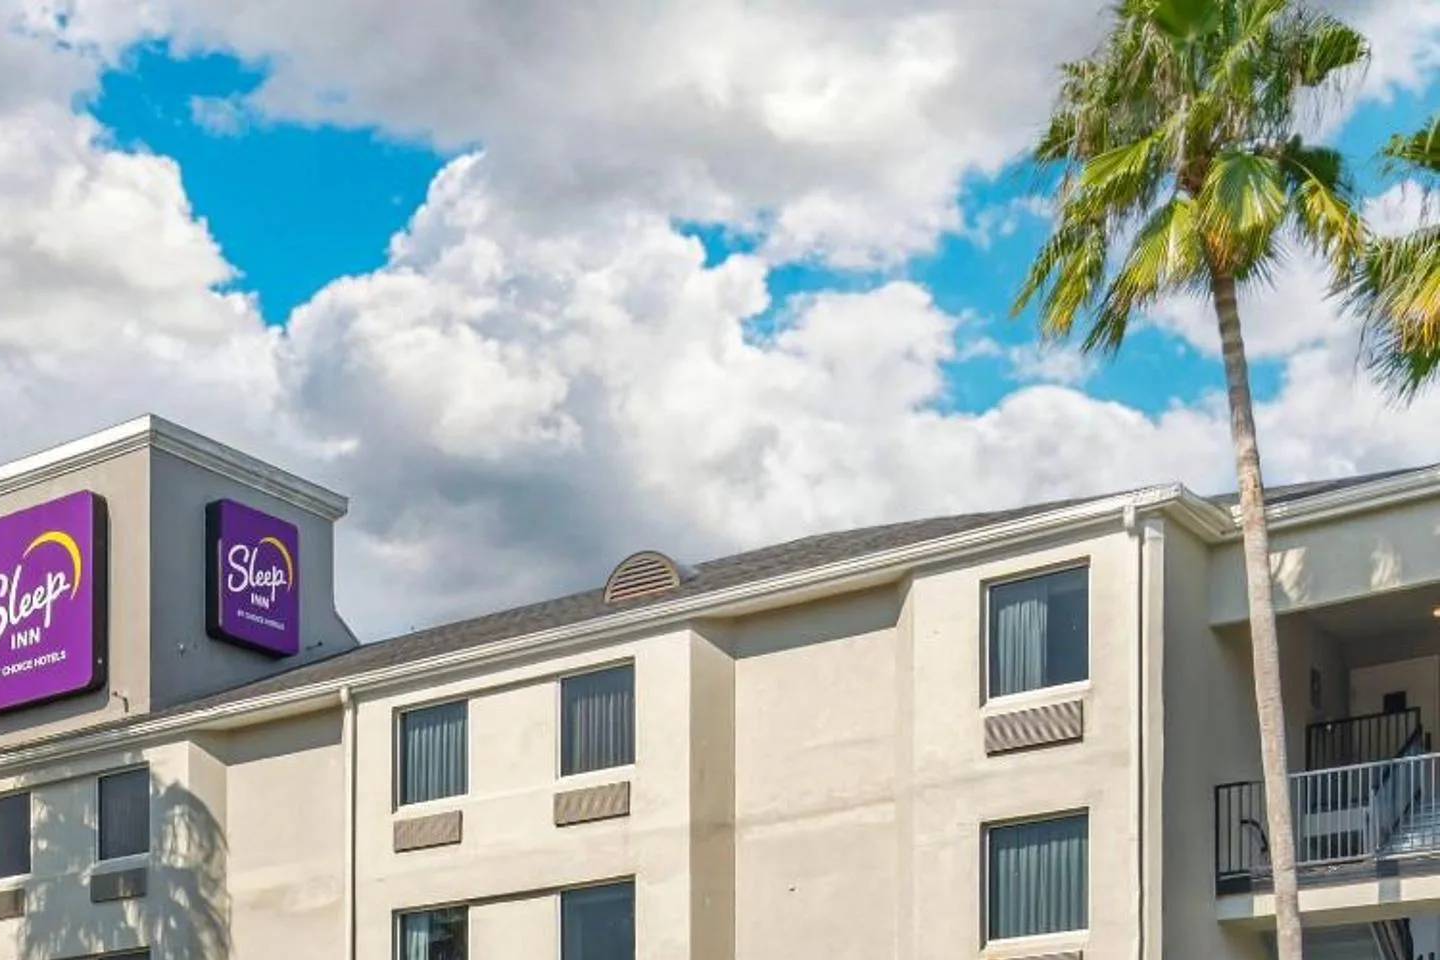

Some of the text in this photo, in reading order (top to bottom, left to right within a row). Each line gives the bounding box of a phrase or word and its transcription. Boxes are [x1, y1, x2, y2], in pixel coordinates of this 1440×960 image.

[228, 544, 287, 602] Sleep
[251, 592, 269, 609] INN
[11, 627, 41, 650] INN
[2, 659, 33, 676] CHOICE
[33, 650, 66, 667] HOTELS
